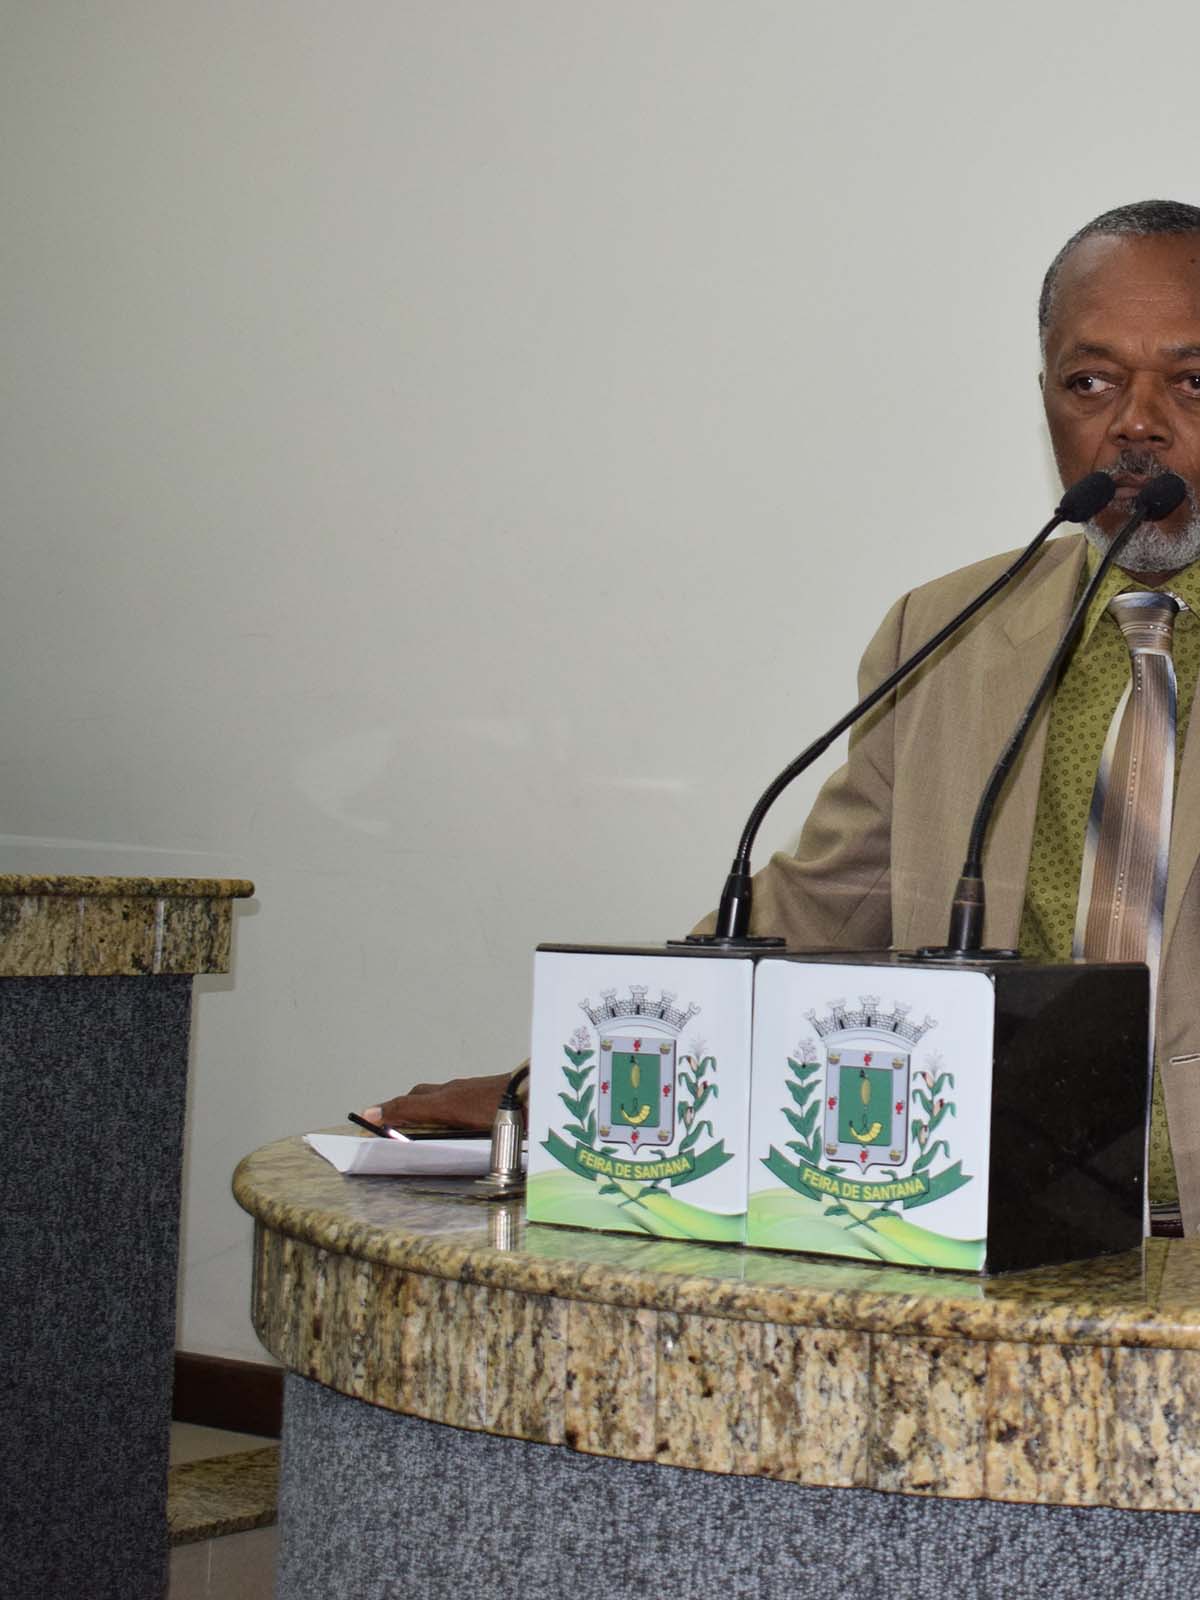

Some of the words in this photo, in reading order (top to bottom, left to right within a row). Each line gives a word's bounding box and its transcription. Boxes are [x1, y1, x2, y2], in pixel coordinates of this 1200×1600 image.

[579, 1150, 613, 1175] FEIRA
[615, 1163, 632, 1177] DE
[634, 1157, 691, 1179] SANTANA
[803, 1168, 840, 1195] FEIRA
[842, 1183, 860, 1199] DE
[863, 1178, 926, 1200] SANTANA
